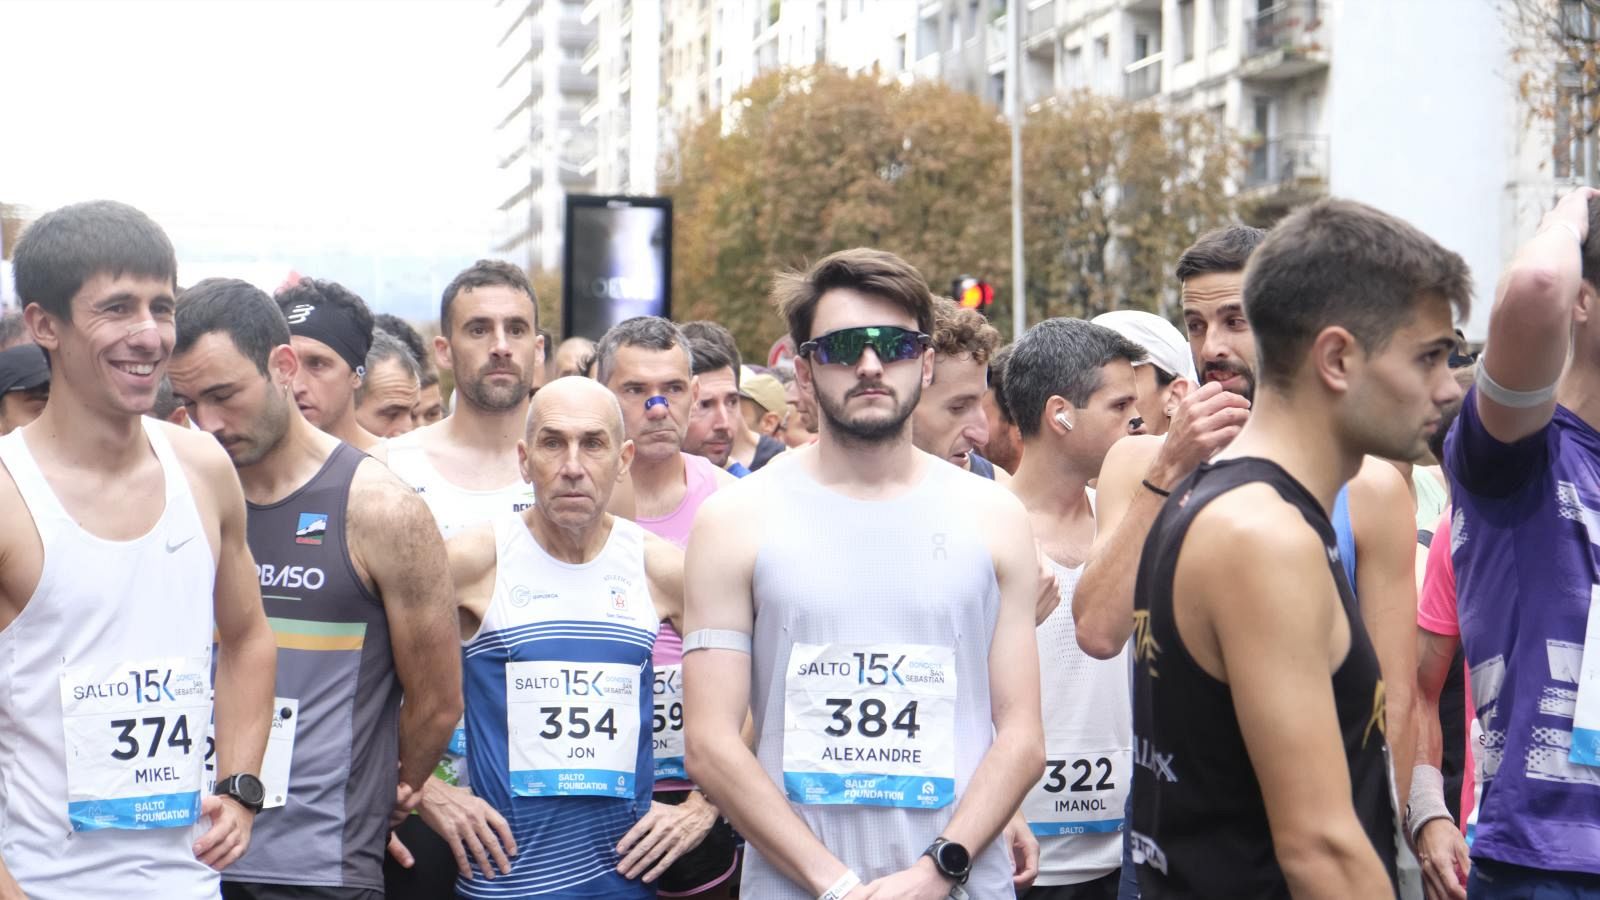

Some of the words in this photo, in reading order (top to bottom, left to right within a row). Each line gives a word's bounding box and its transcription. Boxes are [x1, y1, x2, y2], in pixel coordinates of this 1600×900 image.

[797, 662, 851, 677] SALTO
[853, 652, 906, 686] 15K
[73, 682, 129, 700] SALTO
[129, 669, 176, 703] 15K
[515, 677, 560, 690] SALTO
[560, 669, 604, 696] 15K
[653, 670, 676, 694] 5K
[539, 706, 617, 740] 354
[653, 702, 683, 733] 59
[824, 698, 921, 739] 384
[110, 714, 192, 760] 374
[653, 740, 668, 749] ON
[567, 747, 595, 759] JON
[821, 747, 922, 763] ALEXANDRE
[135, 766, 180, 784] MIKEL
[1043, 758, 1115, 793] 322
[558, 782, 608, 790] FOUNDATION
[844, 779, 875, 789] SALTO
[844, 789, 904, 801] FOUNDATION
[135, 800, 165, 811] SALTO
[1055, 799, 1107, 812] IMANOL
[135, 810, 190, 823] FOUNDATION
[1060, 826, 1084, 834] SALTO
